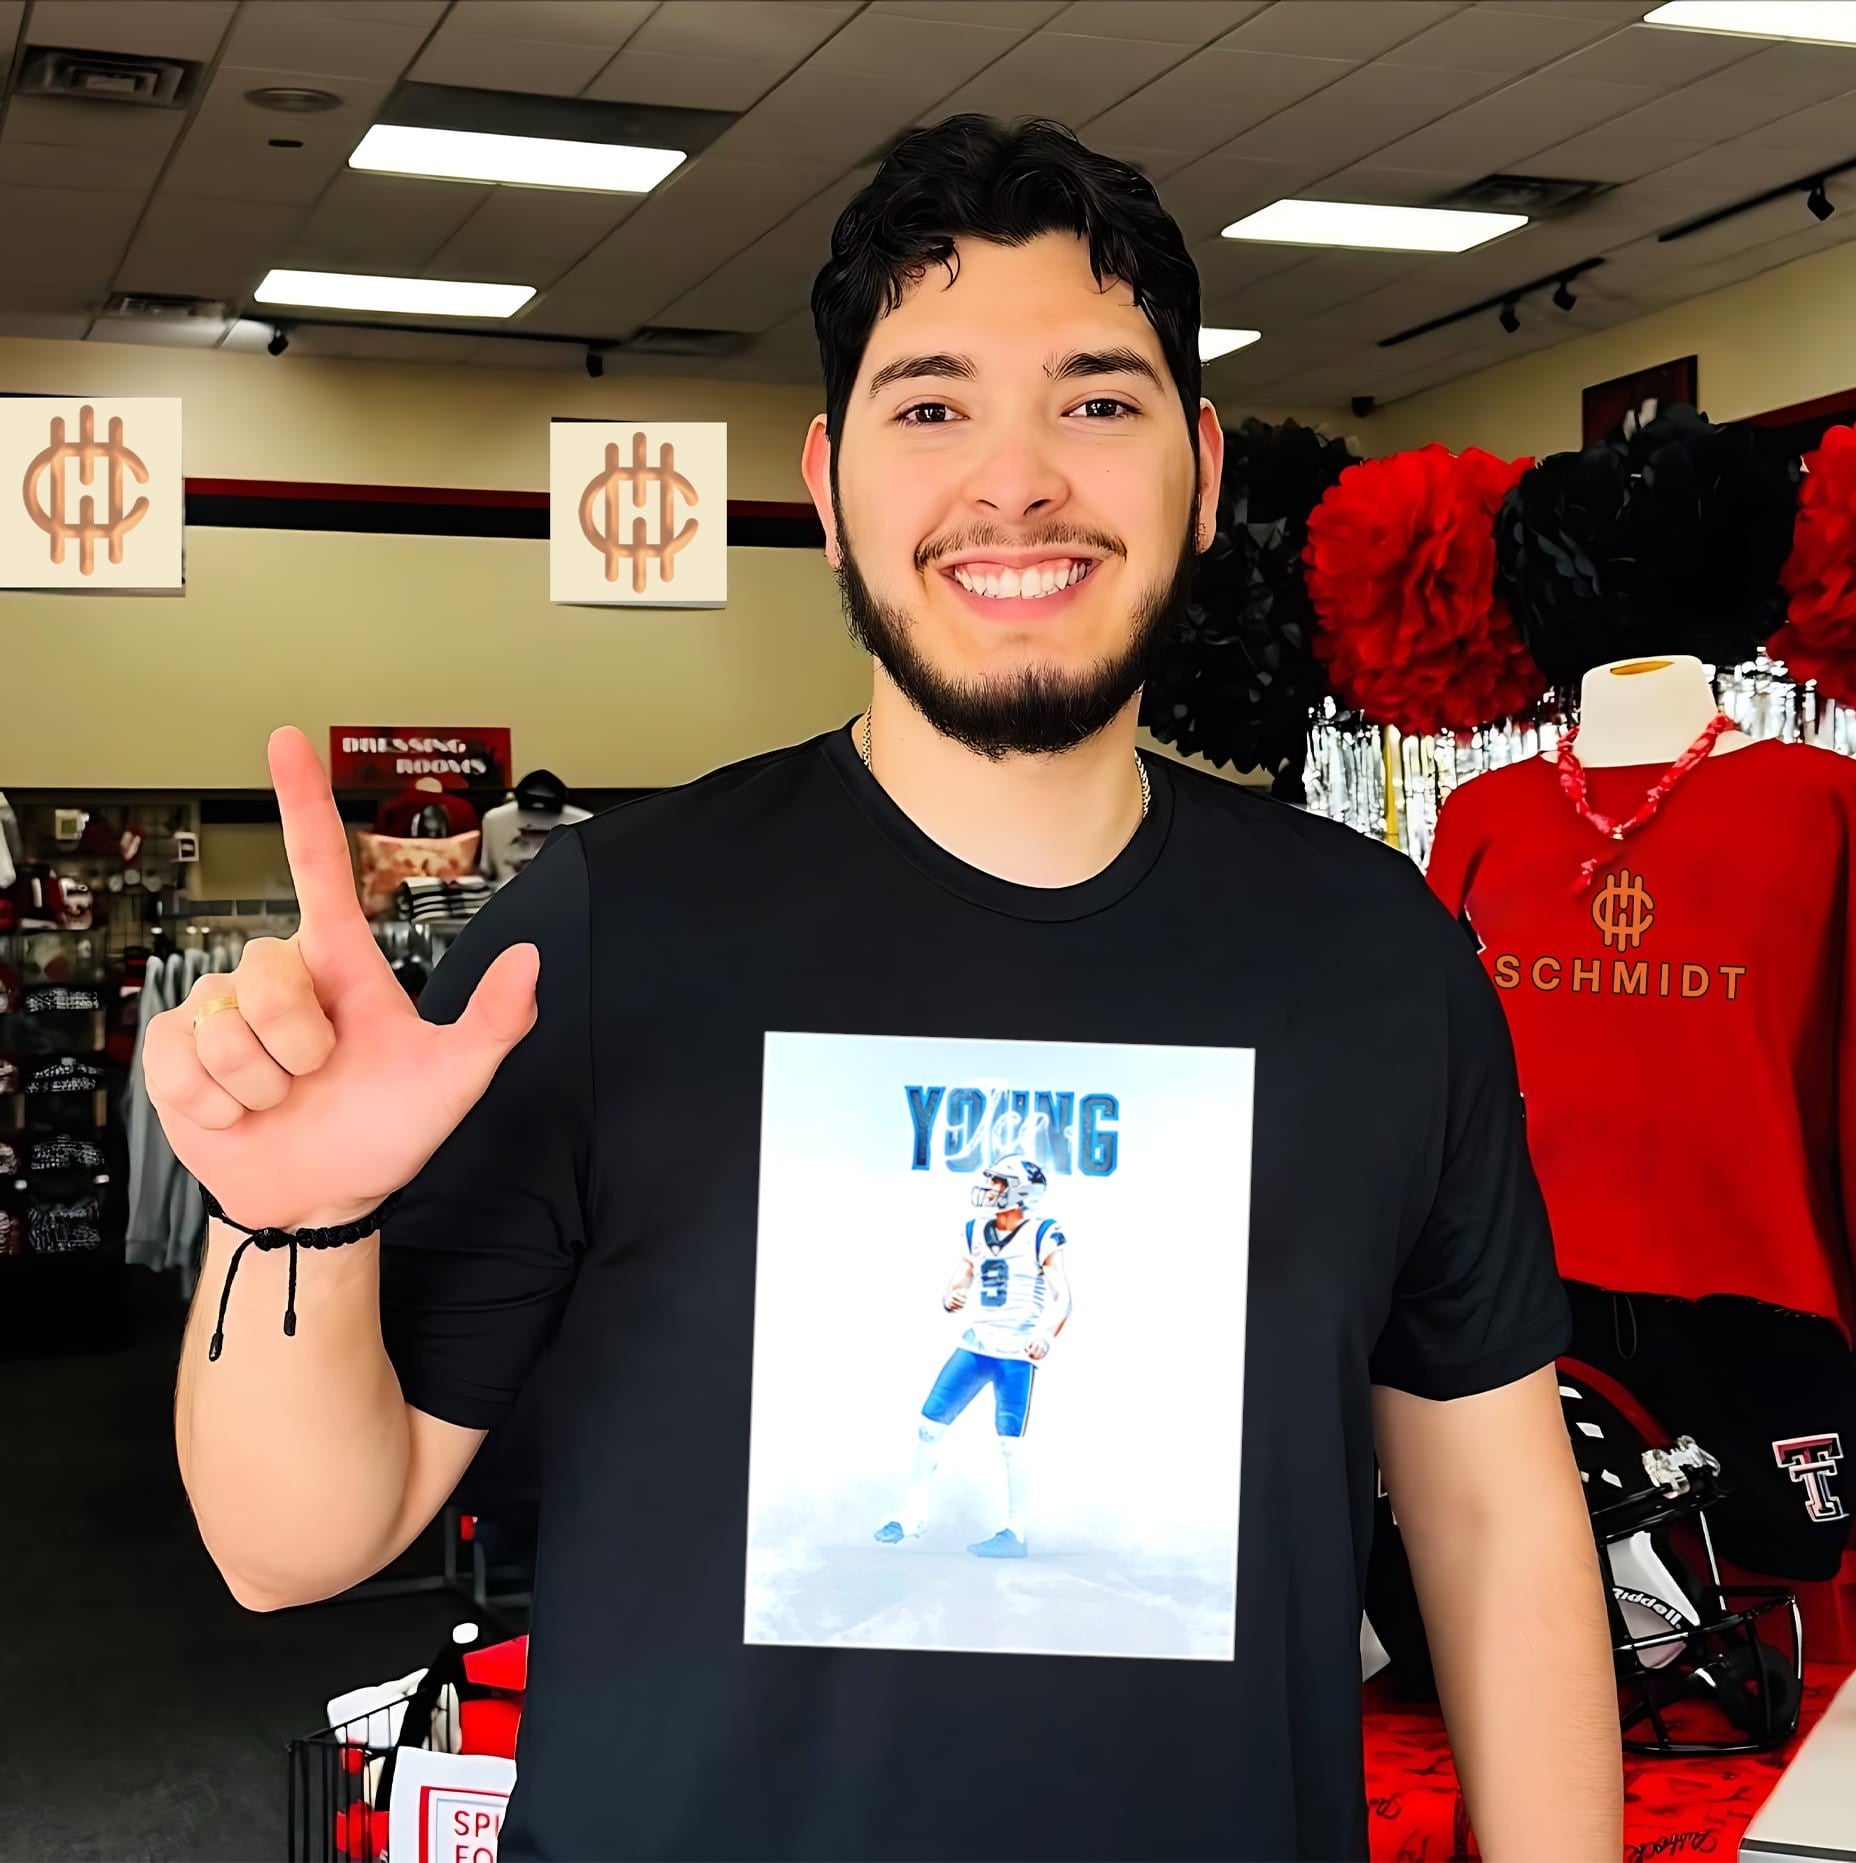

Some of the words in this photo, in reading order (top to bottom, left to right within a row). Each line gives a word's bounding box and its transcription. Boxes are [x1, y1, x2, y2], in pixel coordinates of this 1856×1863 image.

[396, 758, 488, 775] ROOMS
[1494, 953, 1747, 1001] SCHMIDT
[904, 1084, 1120, 1177] YOUNG
[454, 1810, 501, 1838] SPI
[456, 1845, 494, 1863] FO
